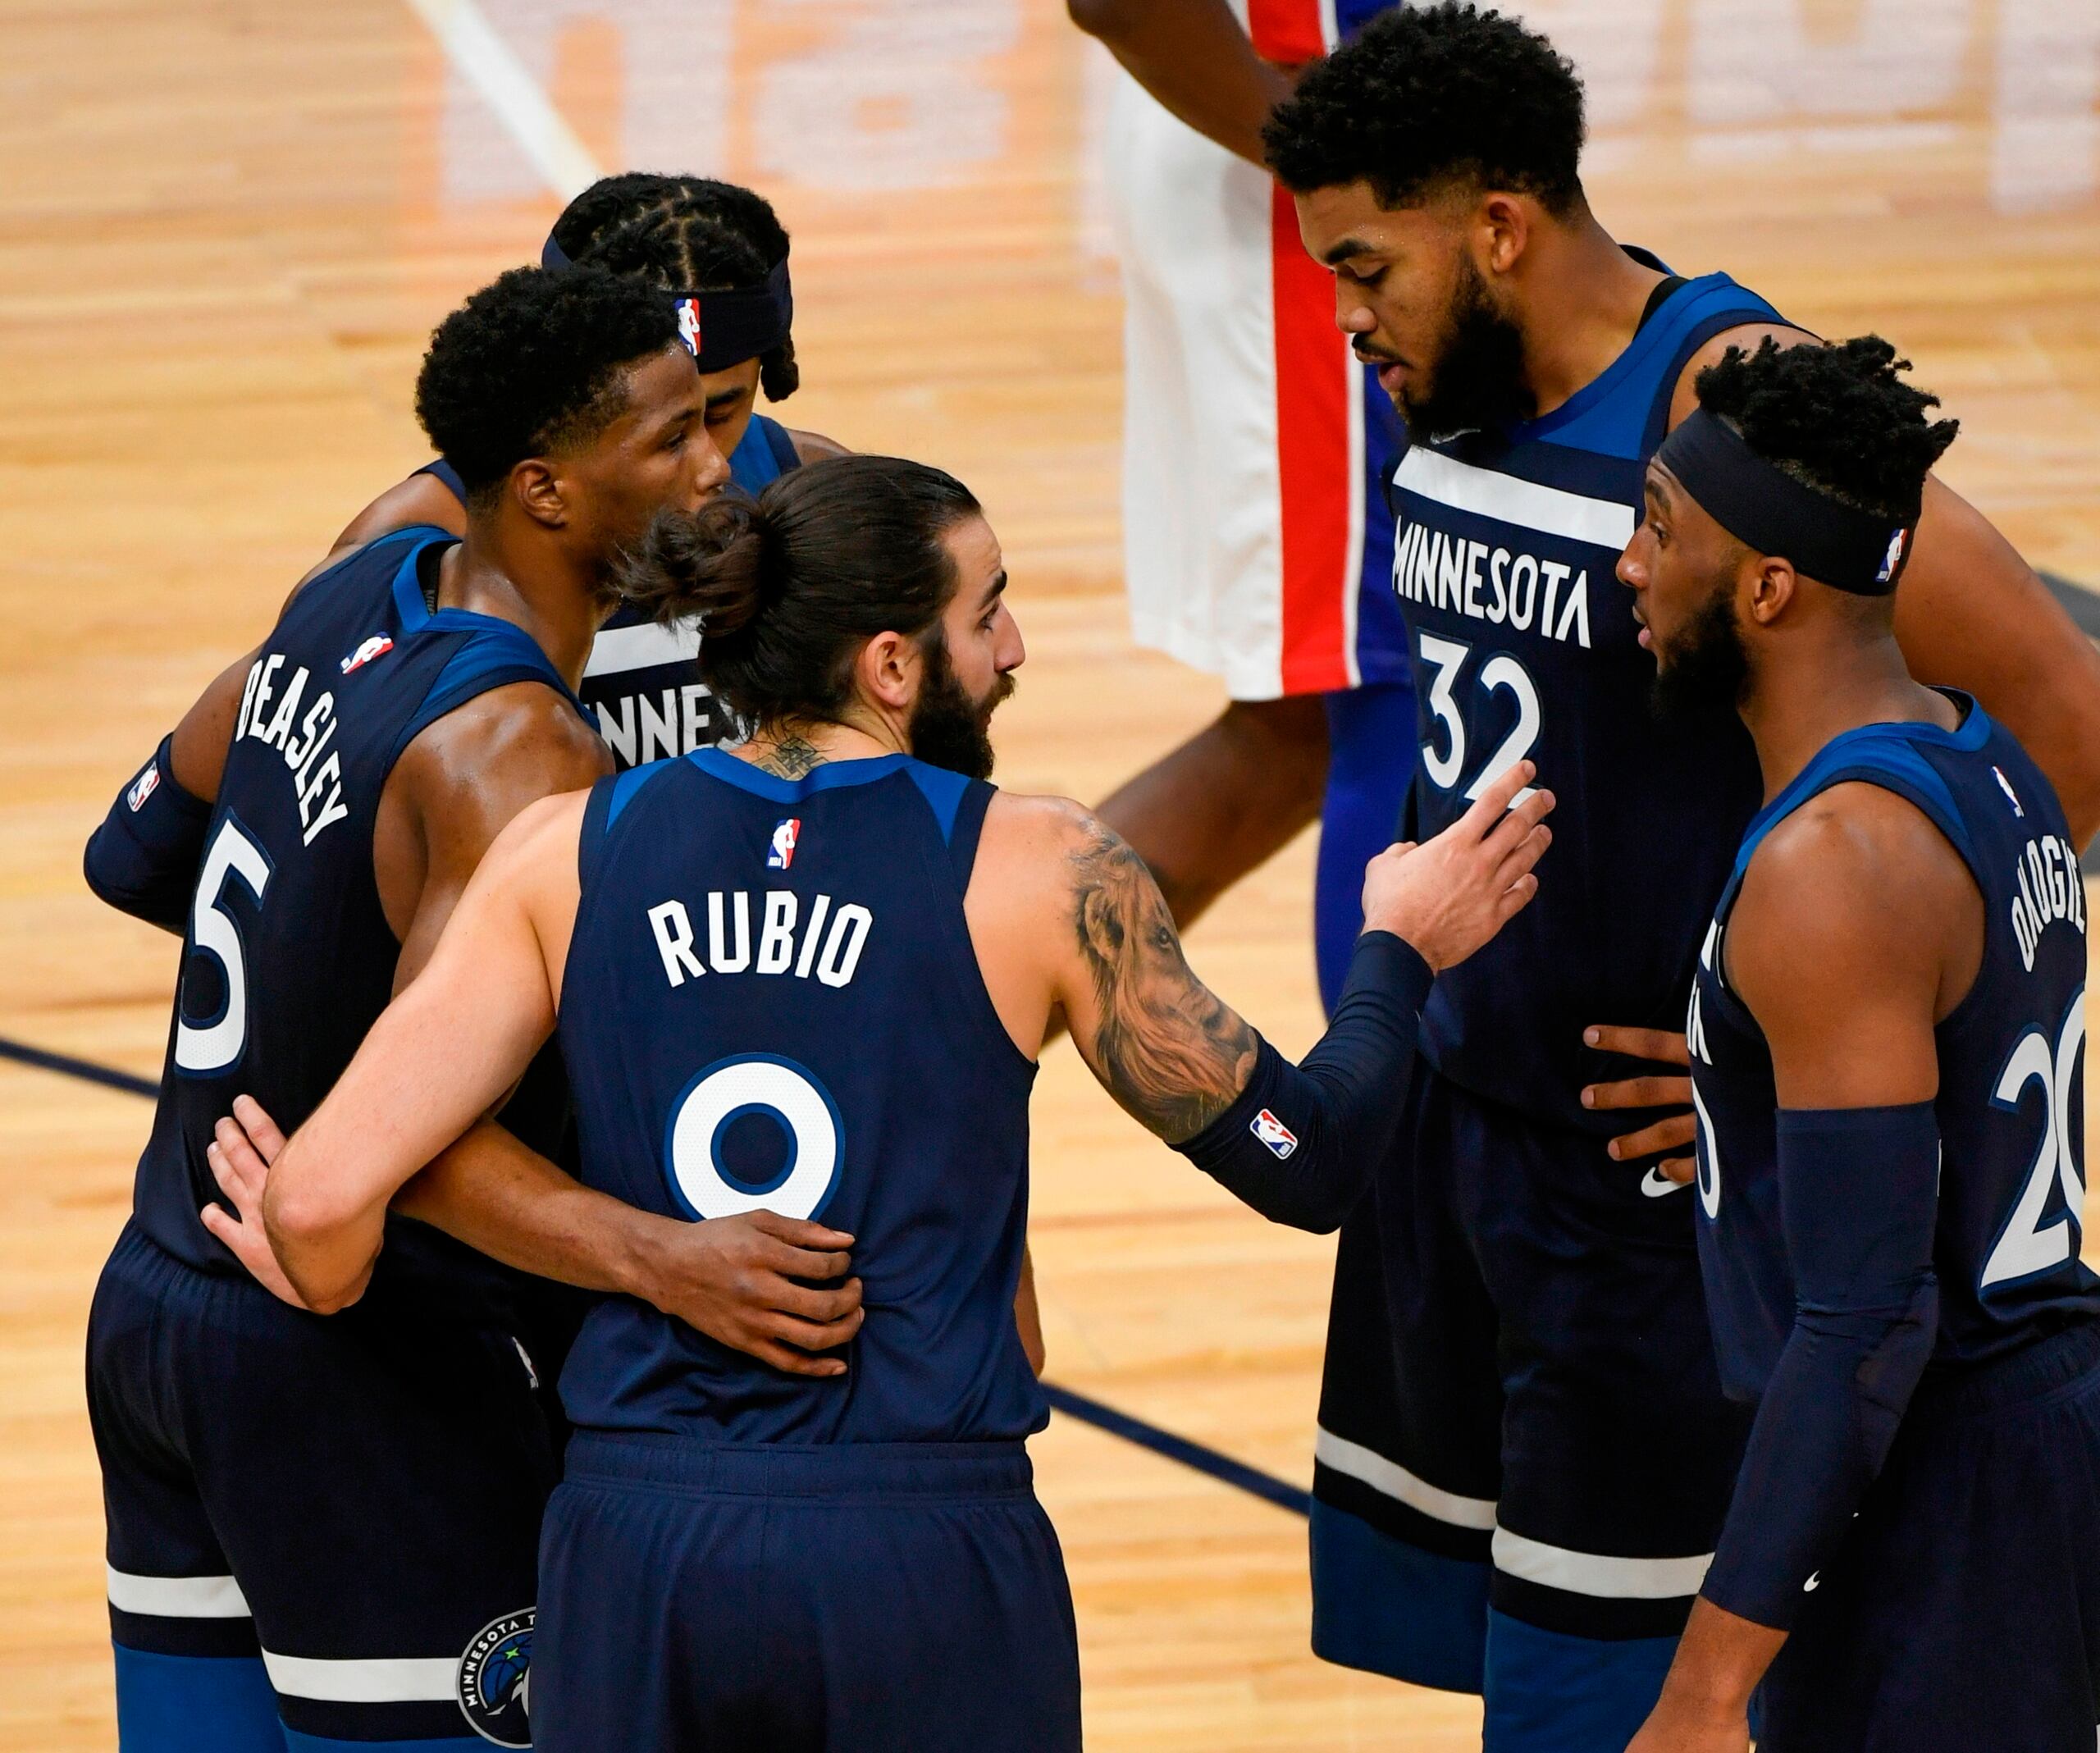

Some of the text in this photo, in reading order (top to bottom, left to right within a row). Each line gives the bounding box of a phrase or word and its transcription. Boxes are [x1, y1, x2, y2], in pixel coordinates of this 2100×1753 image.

[1392, 514, 1591, 649] MINNESOTA
[235, 654, 349, 847] BEASLEY
[584, 683, 760, 768] NNE
[1419, 633, 1541, 810] 32
[175, 819, 271, 1071] 5
[647, 890, 874, 988] RUBIO
[2011, 834, 2086, 973] OKOGIE
[672, 1061, 837, 1221] 0
[463, 1614, 536, 1707] MINNESOTA T
